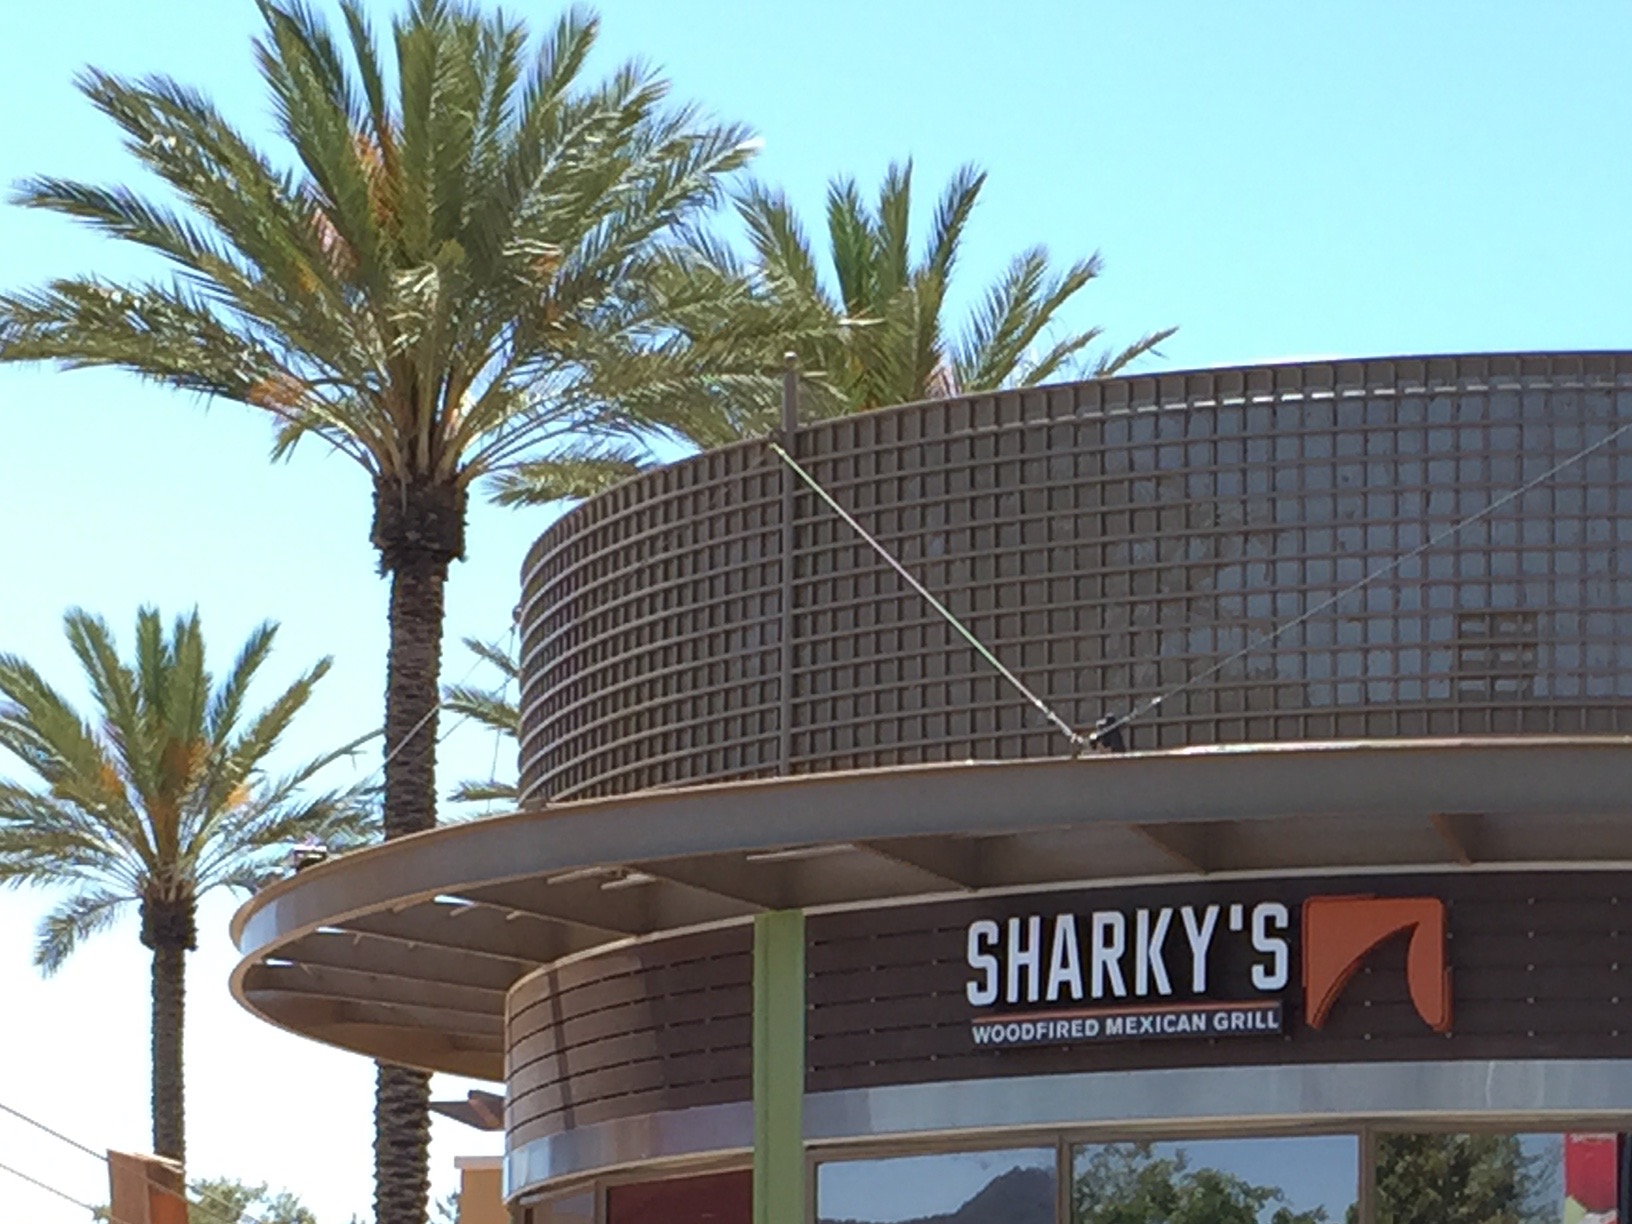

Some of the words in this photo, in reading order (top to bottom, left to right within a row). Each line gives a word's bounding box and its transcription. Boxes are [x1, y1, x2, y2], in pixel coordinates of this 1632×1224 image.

[966, 902, 1290, 1007] SHARKY'S
[971, 1018, 1100, 1044] WOODFIRED
[1105, 1013, 1207, 1036] MEXICAN
[1212, 1010, 1280, 1031] GRILL
